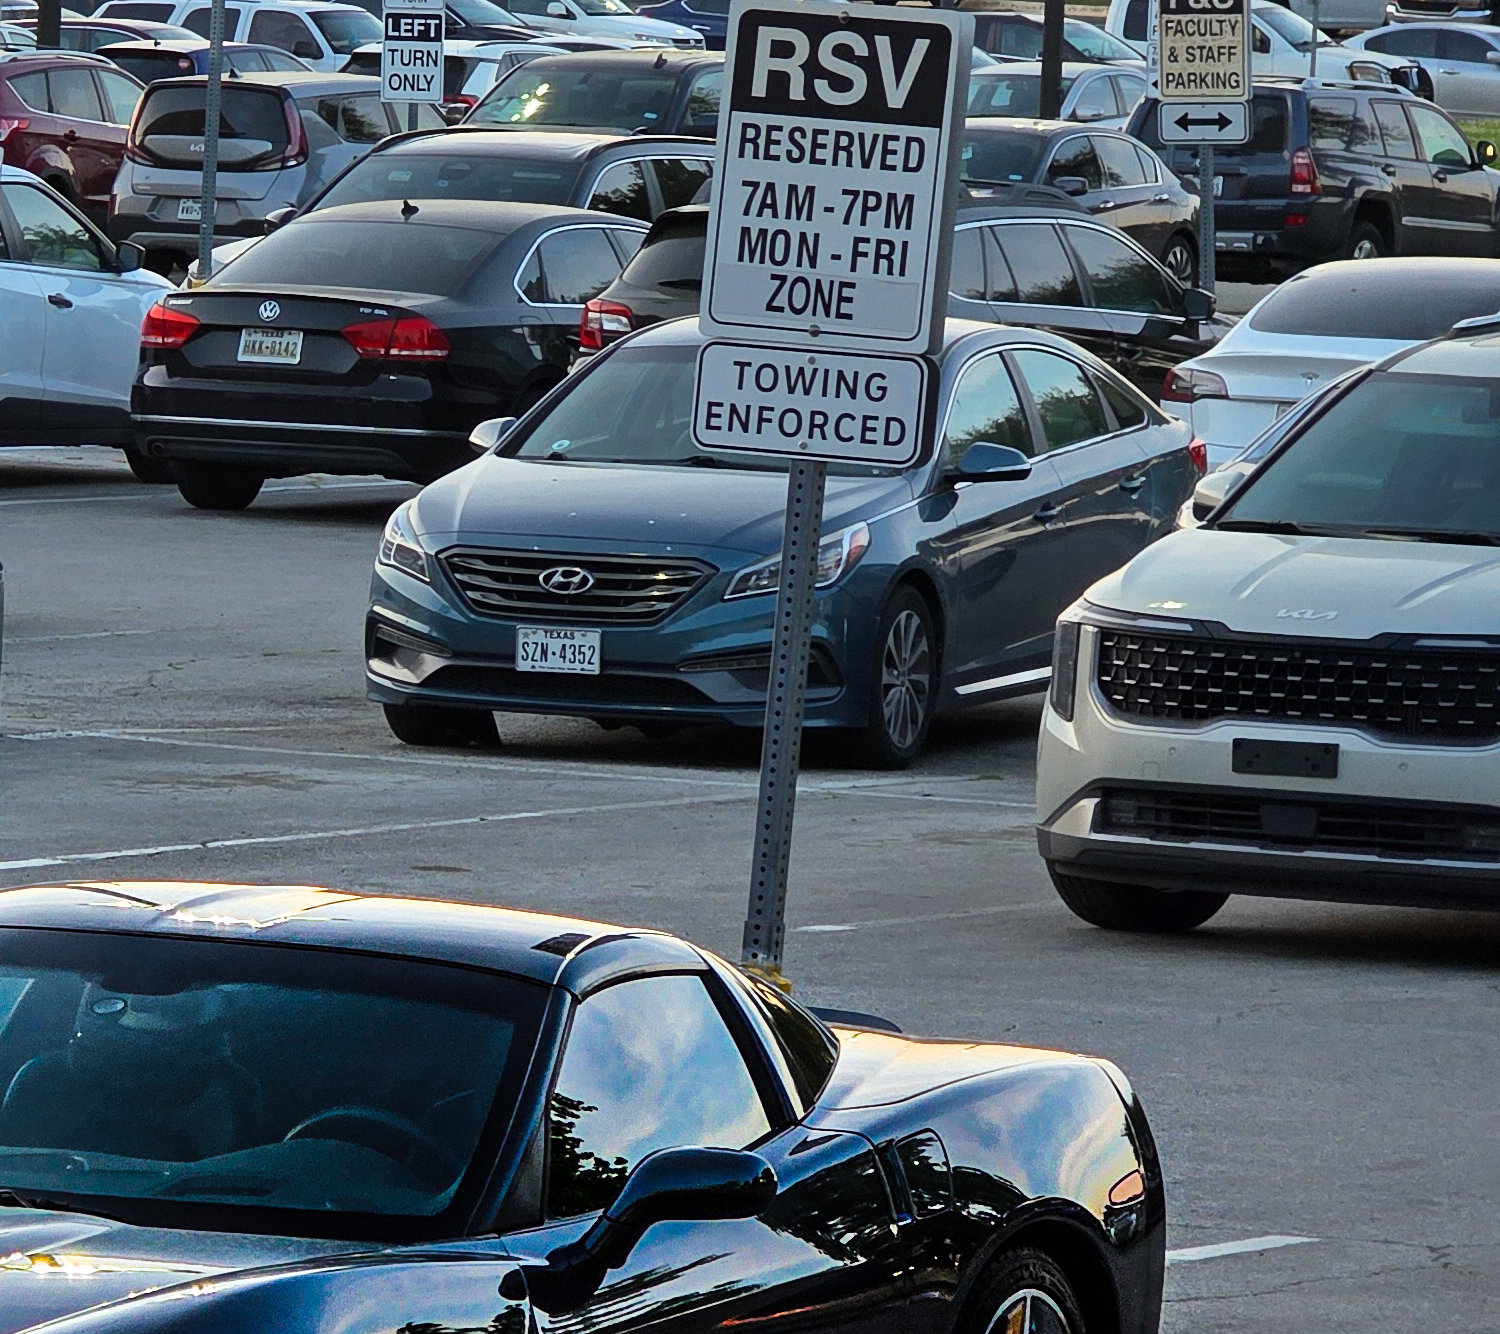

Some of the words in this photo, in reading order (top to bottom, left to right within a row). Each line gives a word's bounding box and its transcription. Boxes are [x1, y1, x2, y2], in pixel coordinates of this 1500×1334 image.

[387, 17, 440, 38] LEFT
[1164, 18, 1239, 37] FACULTY
[387, 49, 439, 68] TURN
[1167, 46, 1179, 63] &
[1185, 45, 1238, 63] STAFF
[751, 25, 931, 109] RSV
[388, 73, 435, 92] ONLY
[1165, 71, 1240, 89] PARKING
[738, 122, 926, 173] RESERVED
[765, 273, 857, 320] ZONE
[261, 330, 285, 338] TEXAS
[733, 360, 889, 402] TOWING
[705, 400, 907, 447] ENFORCED
[1276, 608, 1339, 620] KIA
[543, 630, 576, 640] TEXAS
